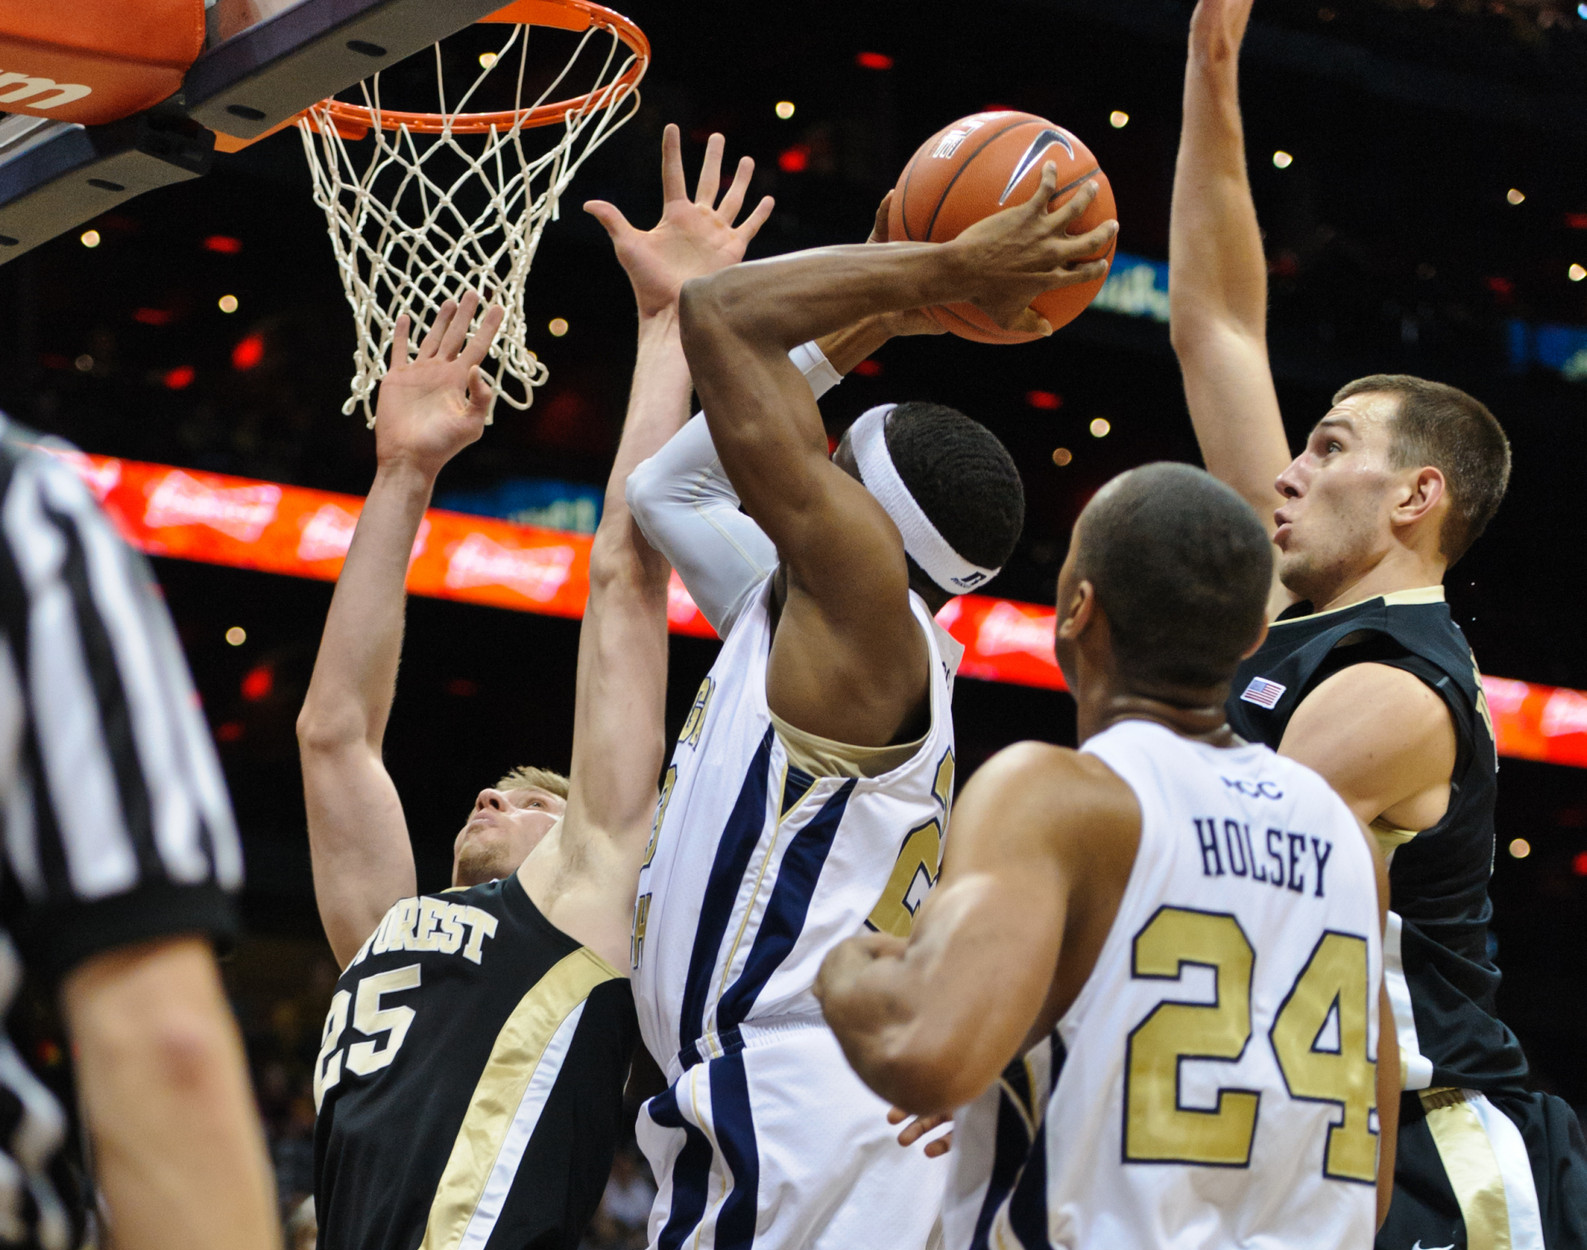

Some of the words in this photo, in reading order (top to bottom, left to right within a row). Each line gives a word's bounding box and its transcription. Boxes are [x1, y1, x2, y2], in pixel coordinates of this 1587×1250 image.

[1193, 818, 1332, 898] HOLSEY
[313, 963, 421, 1116] 25
[1121, 904, 1380, 1186] 24
